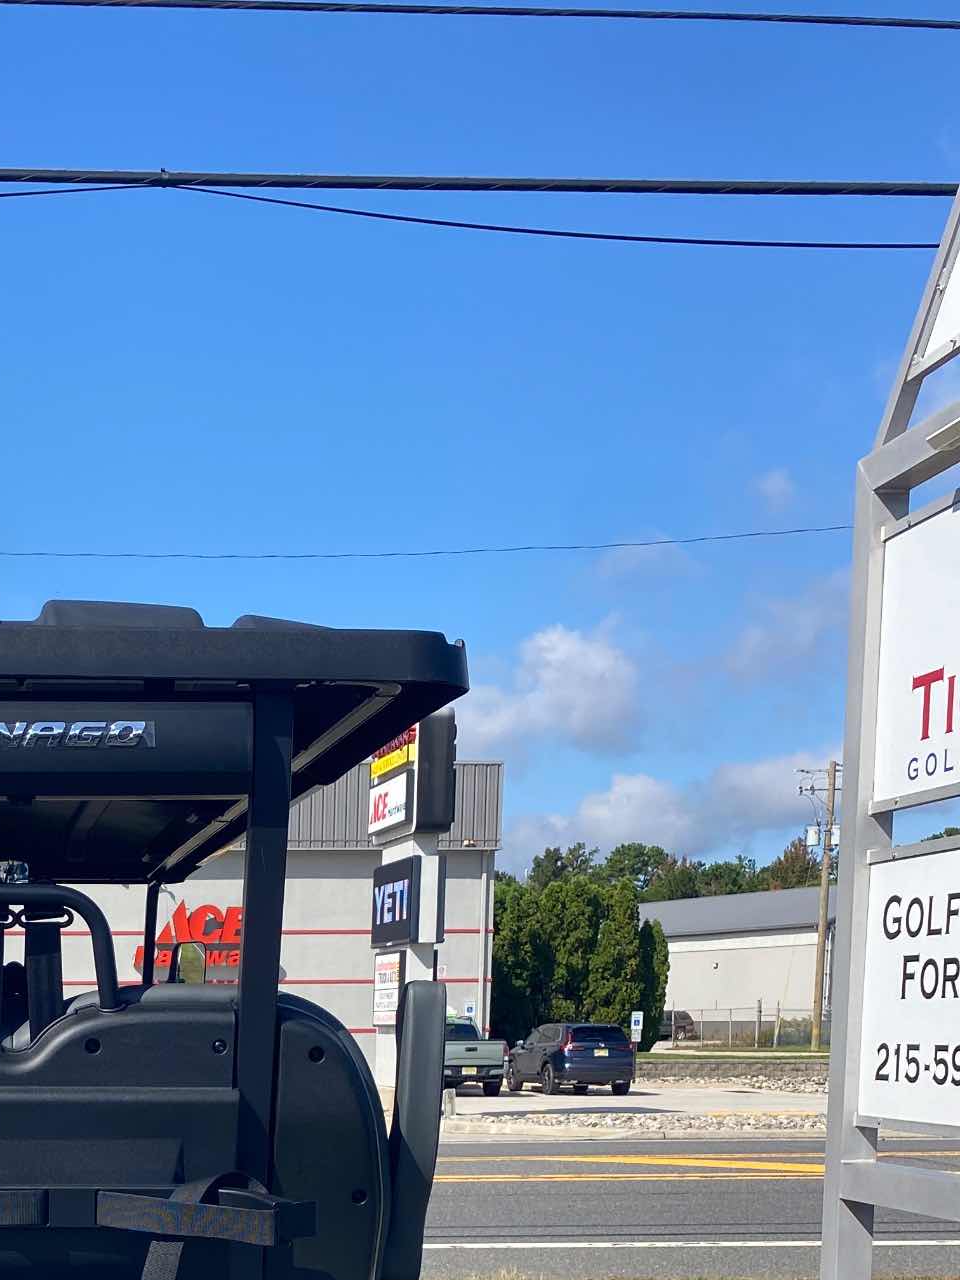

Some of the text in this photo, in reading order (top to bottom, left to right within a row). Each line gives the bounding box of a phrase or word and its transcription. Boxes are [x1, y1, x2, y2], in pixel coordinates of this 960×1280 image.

[912, 665, 960, 740] TI
[155, 899, 244, 943] ACE
[375, 879, 409, 925] YETI
[883, 893, 960, 940] GOLF
[900, 953, 960, 999] FOR
